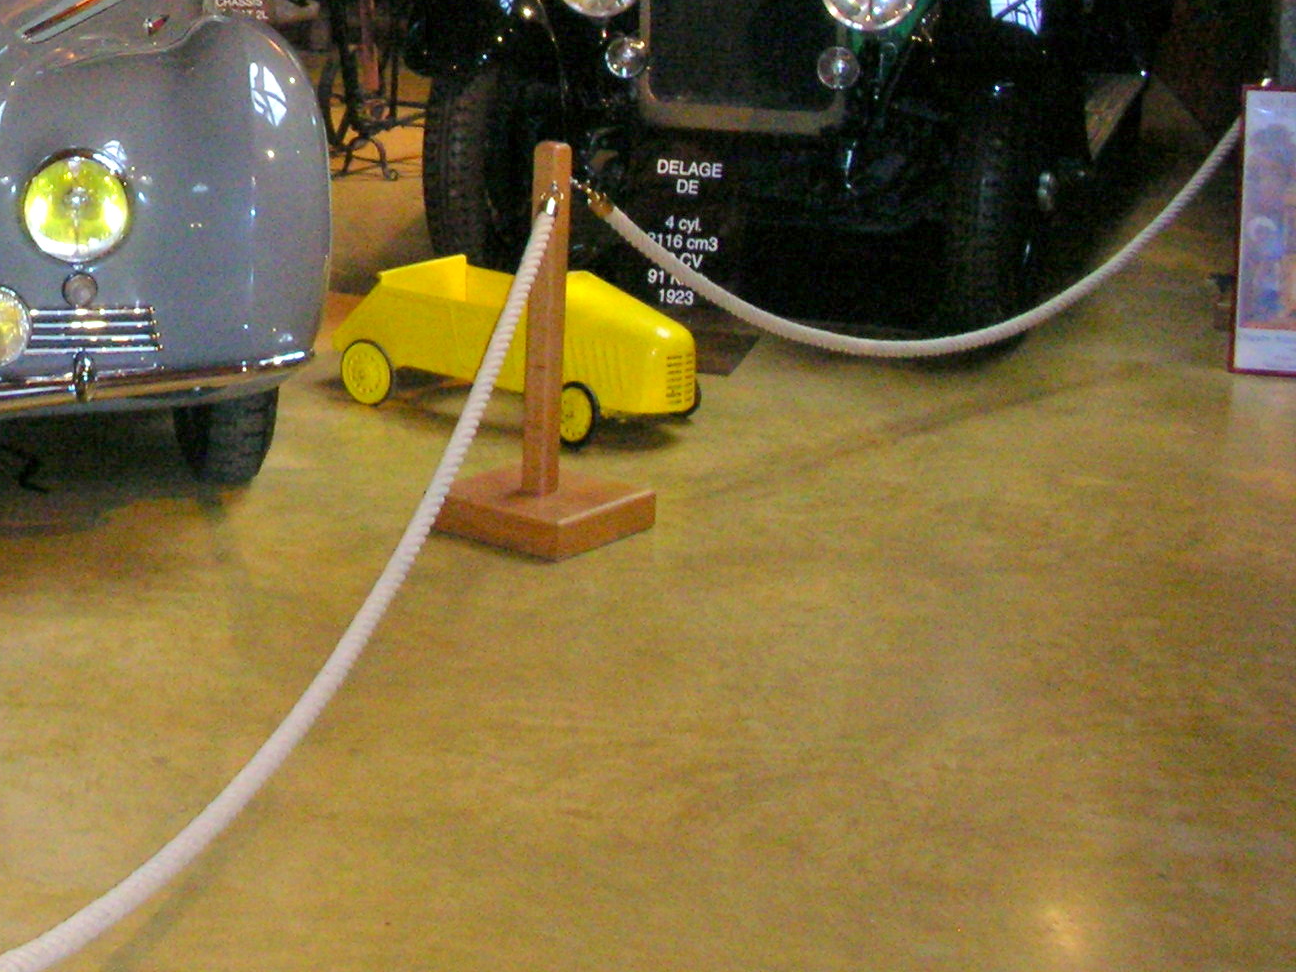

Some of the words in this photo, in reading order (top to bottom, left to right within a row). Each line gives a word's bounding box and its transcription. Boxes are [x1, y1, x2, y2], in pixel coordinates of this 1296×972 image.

[656, 158, 723, 179] DELAGE
[676, 178, 700, 195] DE
[664, 215, 675, 230] 4
[678, 216, 702, 235] cyl.
[686, 236, 719, 252] cm3
[680, 252, 703, 269] CV
[647, 268, 665, 285] 91
[659, 288, 694, 306] 1923
